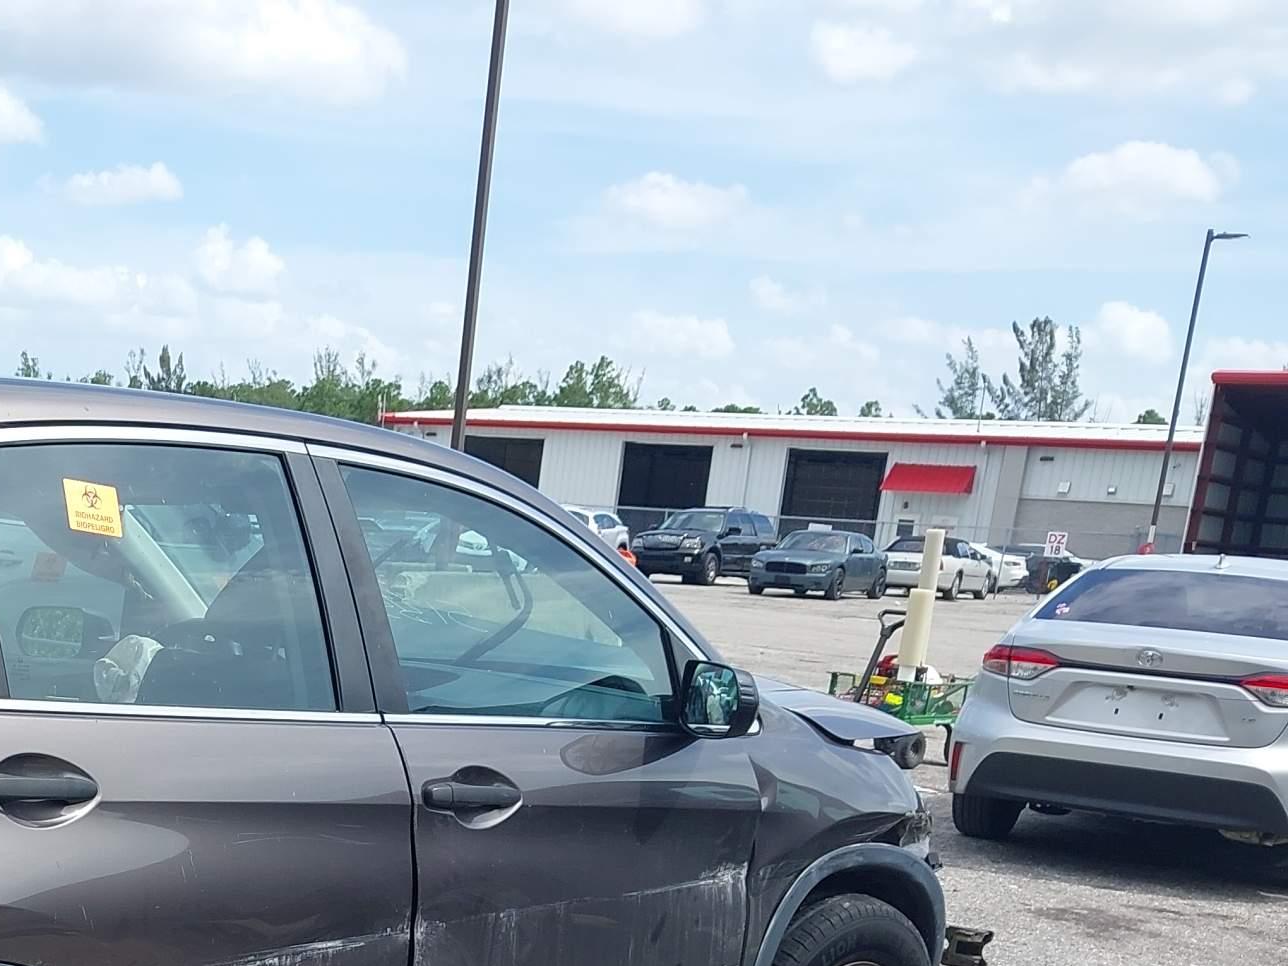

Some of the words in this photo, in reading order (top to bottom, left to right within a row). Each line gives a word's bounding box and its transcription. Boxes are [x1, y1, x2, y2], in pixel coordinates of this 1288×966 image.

[74, 510, 114, 524] BIOHAZARD
[76, 520, 115, 534] BIOPELIGRO
[1048, 533, 1066, 545] DZ
[1049, 545, 1061, 556] 18
